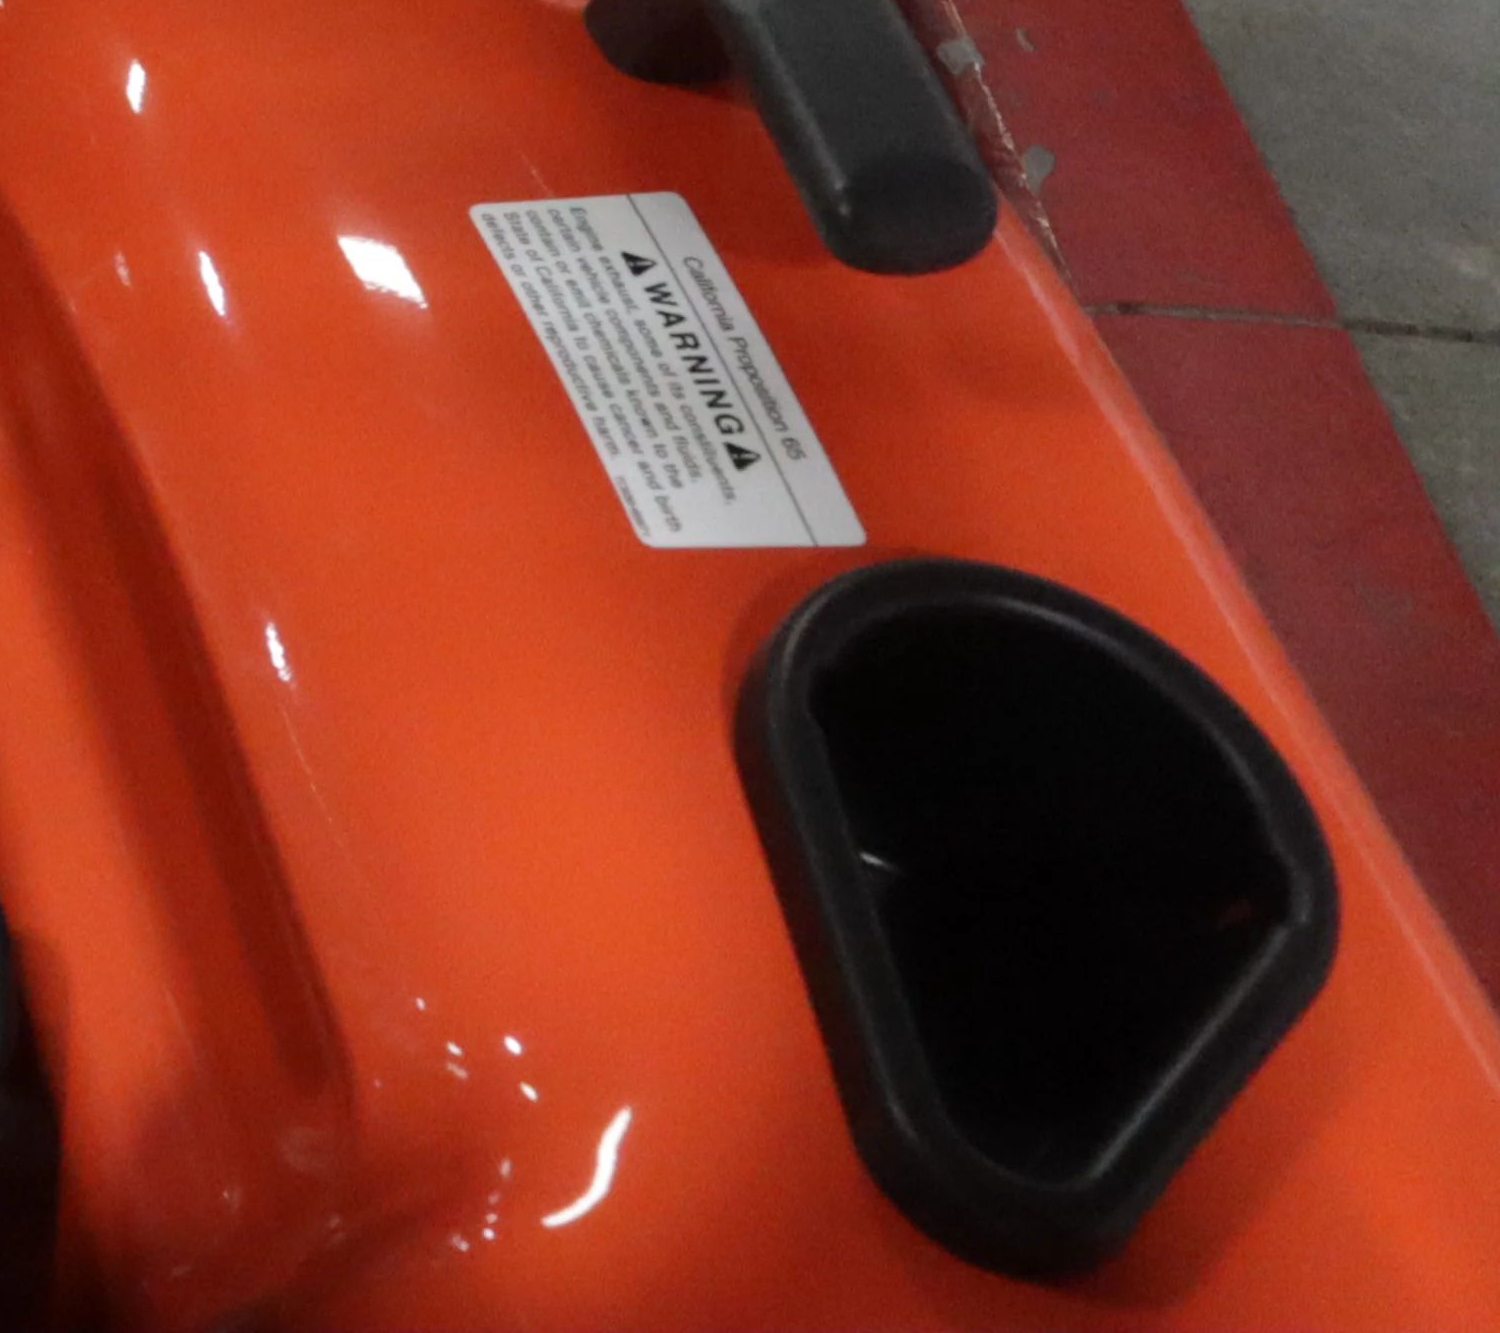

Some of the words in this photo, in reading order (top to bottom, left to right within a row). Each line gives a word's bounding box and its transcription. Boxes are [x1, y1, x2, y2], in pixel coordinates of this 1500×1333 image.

[643, 283, 745, 434] WARNING
[683, 257, 734, 329] California
[724, 337, 789, 429] Proposition
[781, 438, 805, 458] 65
